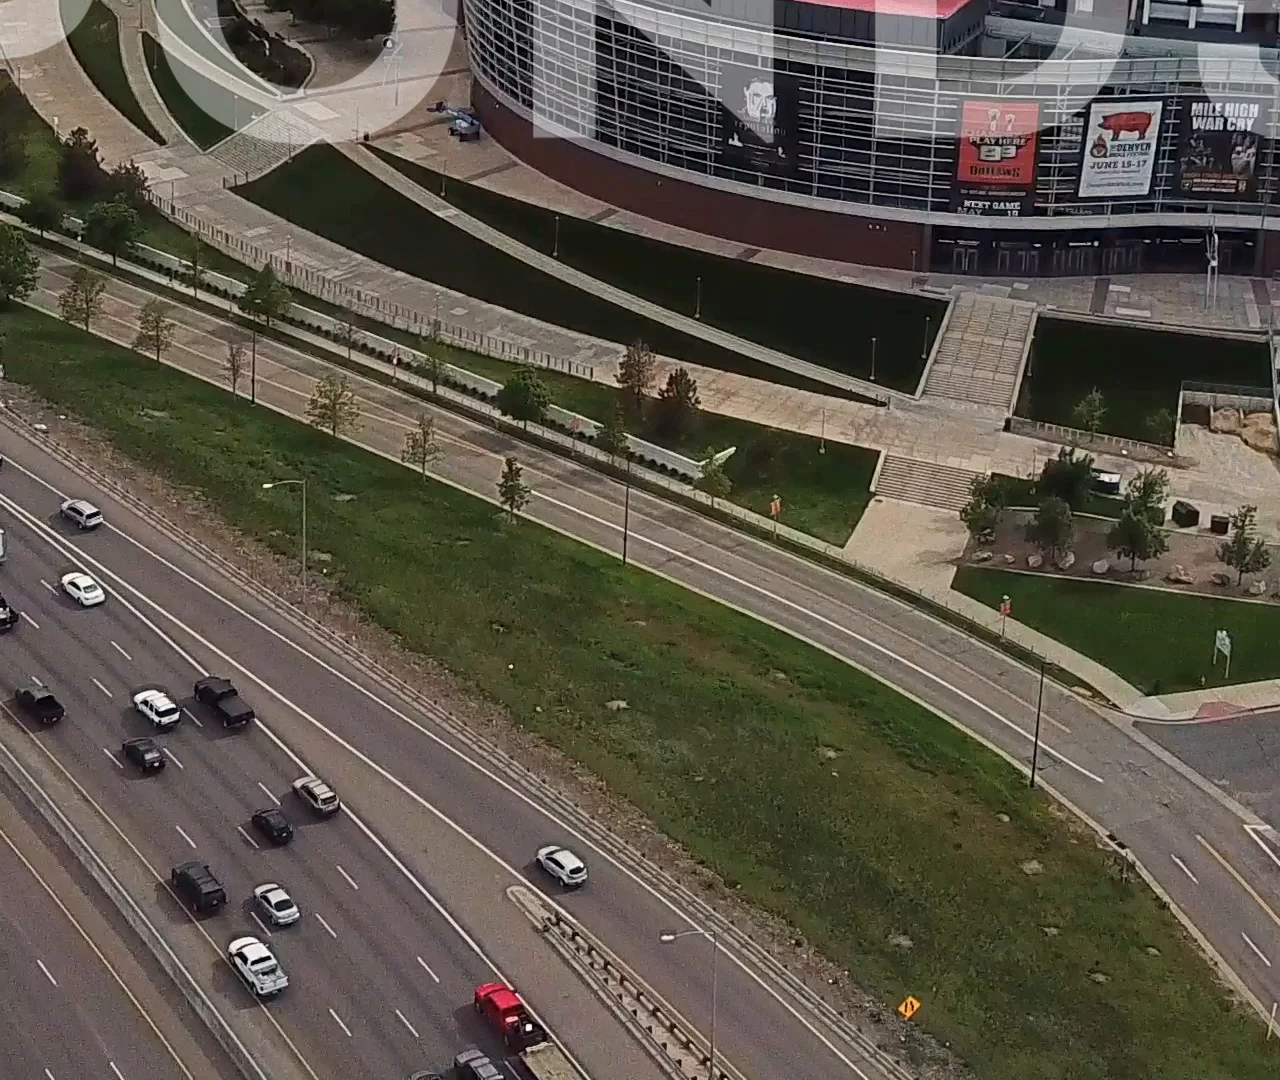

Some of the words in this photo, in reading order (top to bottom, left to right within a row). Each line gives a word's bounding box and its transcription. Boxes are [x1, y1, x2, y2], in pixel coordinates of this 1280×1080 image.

[1190, 102, 1223, 116] MILE
[1224, 103, 1259, 117] HIGH
[1192, 116, 1224, 130] WAR
[1226, 117, 1255, 131] CRY
[969, 136, 997, 145] PLAY
[998, 137, 1027, 146] HERE
[1116, 142, 1151, 152] DENVER
[1089, 160, 1119, 169] JUNE
[963, 199, 991, 209] NEXT
[992, 201, 1021, 210] GAME
[956, 206, 983, 216] MAY
